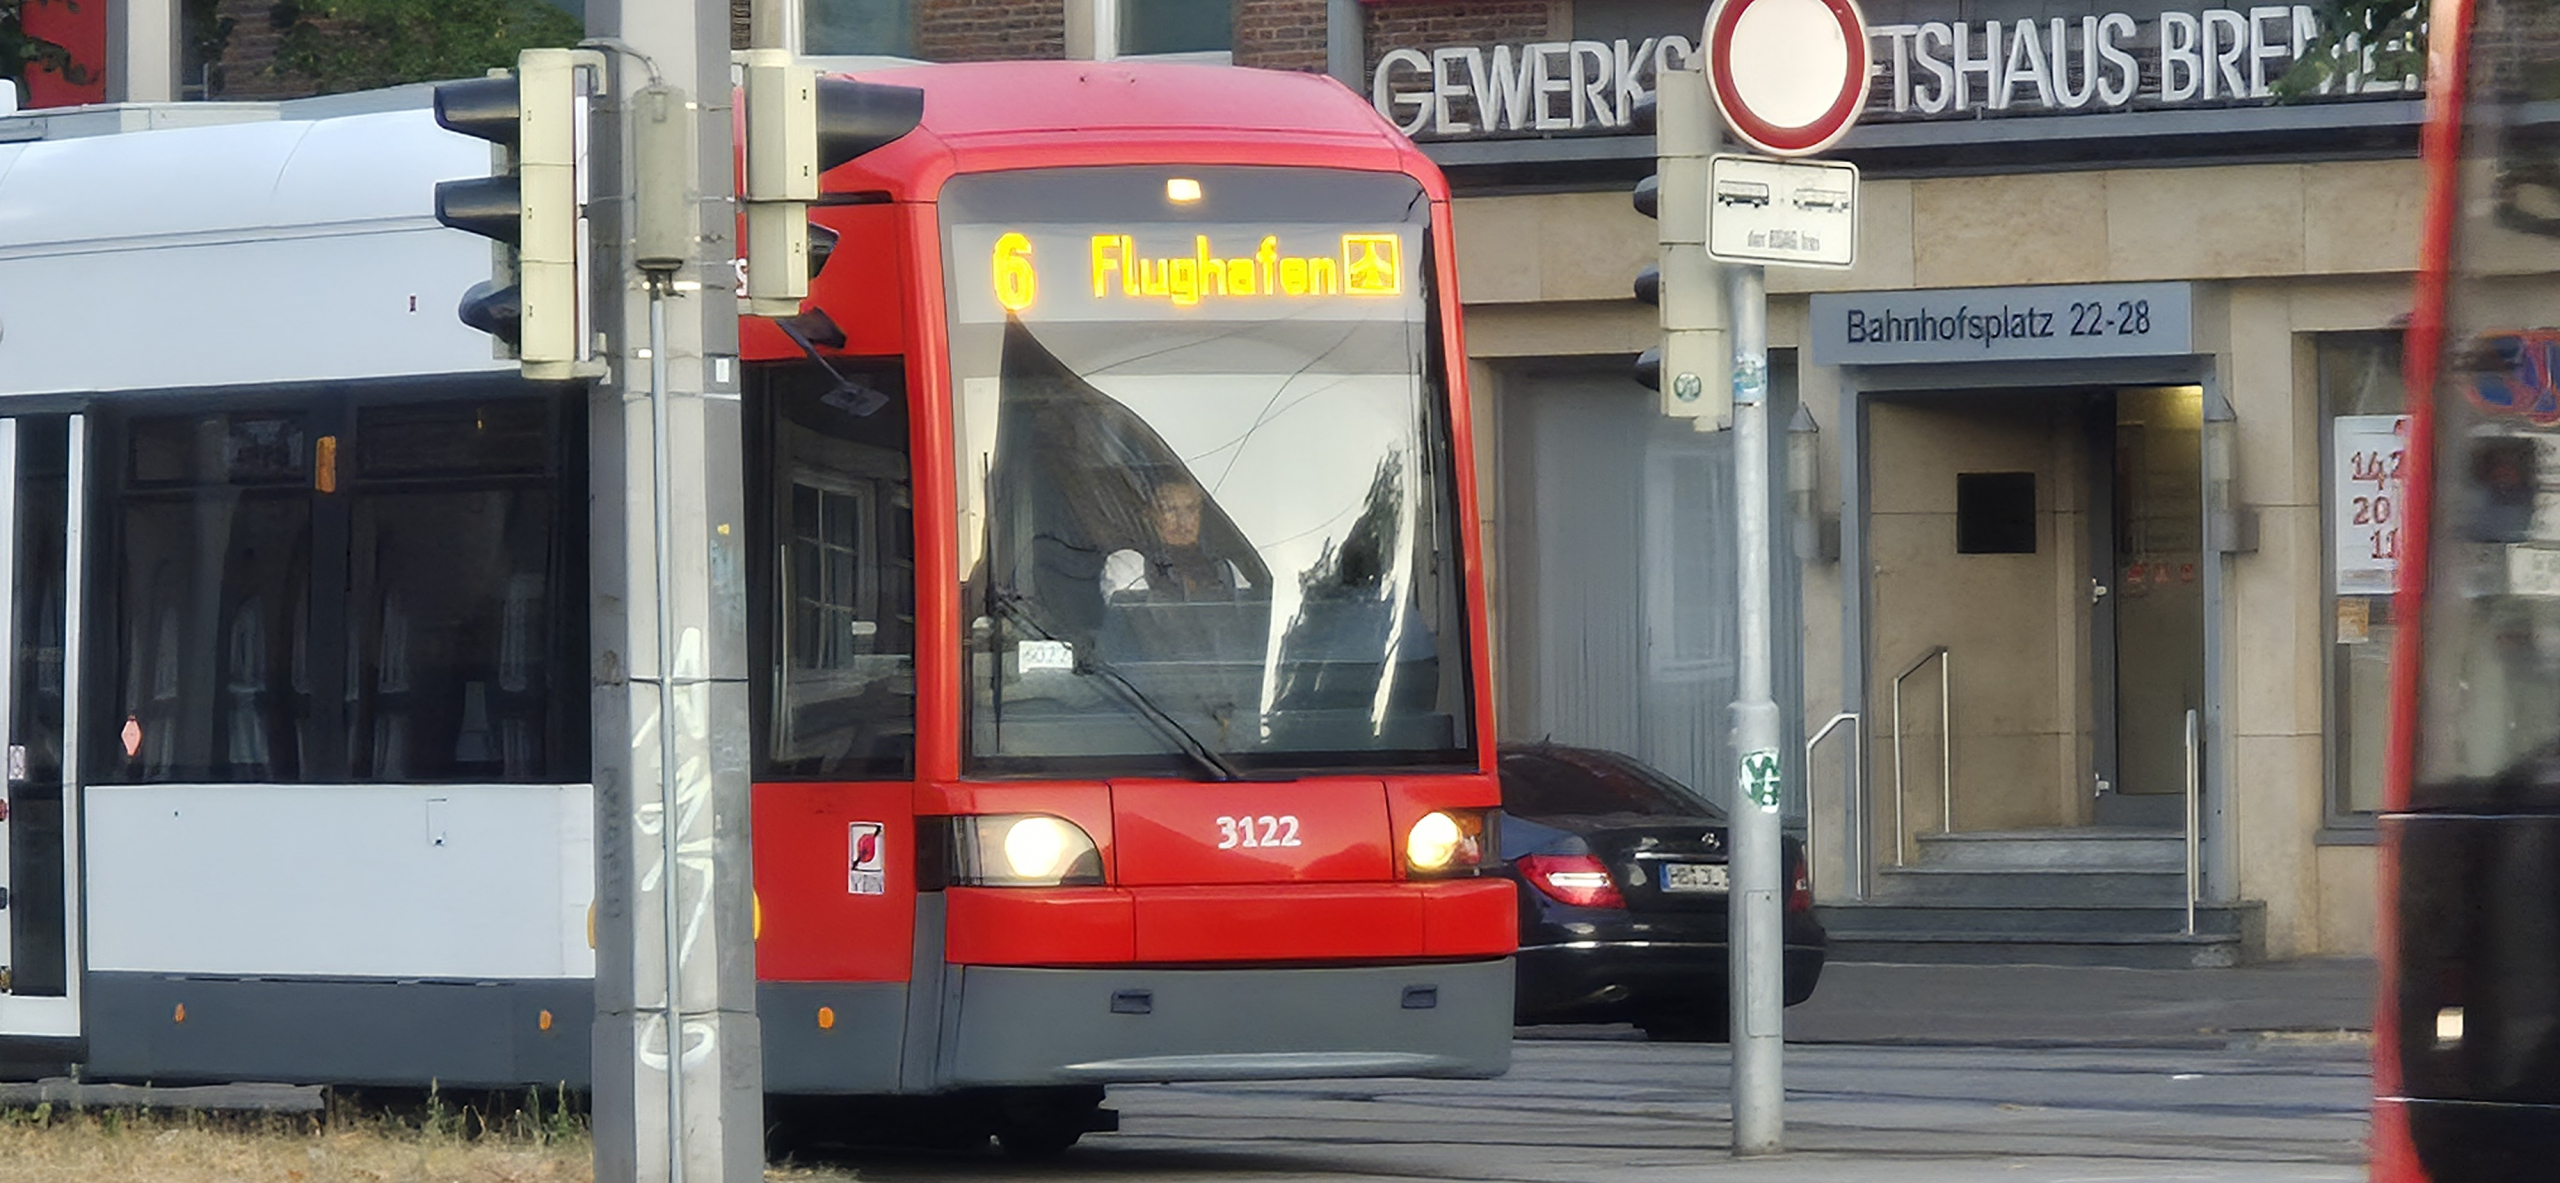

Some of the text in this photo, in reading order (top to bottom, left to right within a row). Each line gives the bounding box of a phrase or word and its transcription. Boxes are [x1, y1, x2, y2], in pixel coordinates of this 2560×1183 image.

[992, 231, 1339, 311] 6 Flughafen
[1847, 299, 2150, 349] Bahnhofsplatz 22-28
[1216, 815, 1302, 850] 3122
